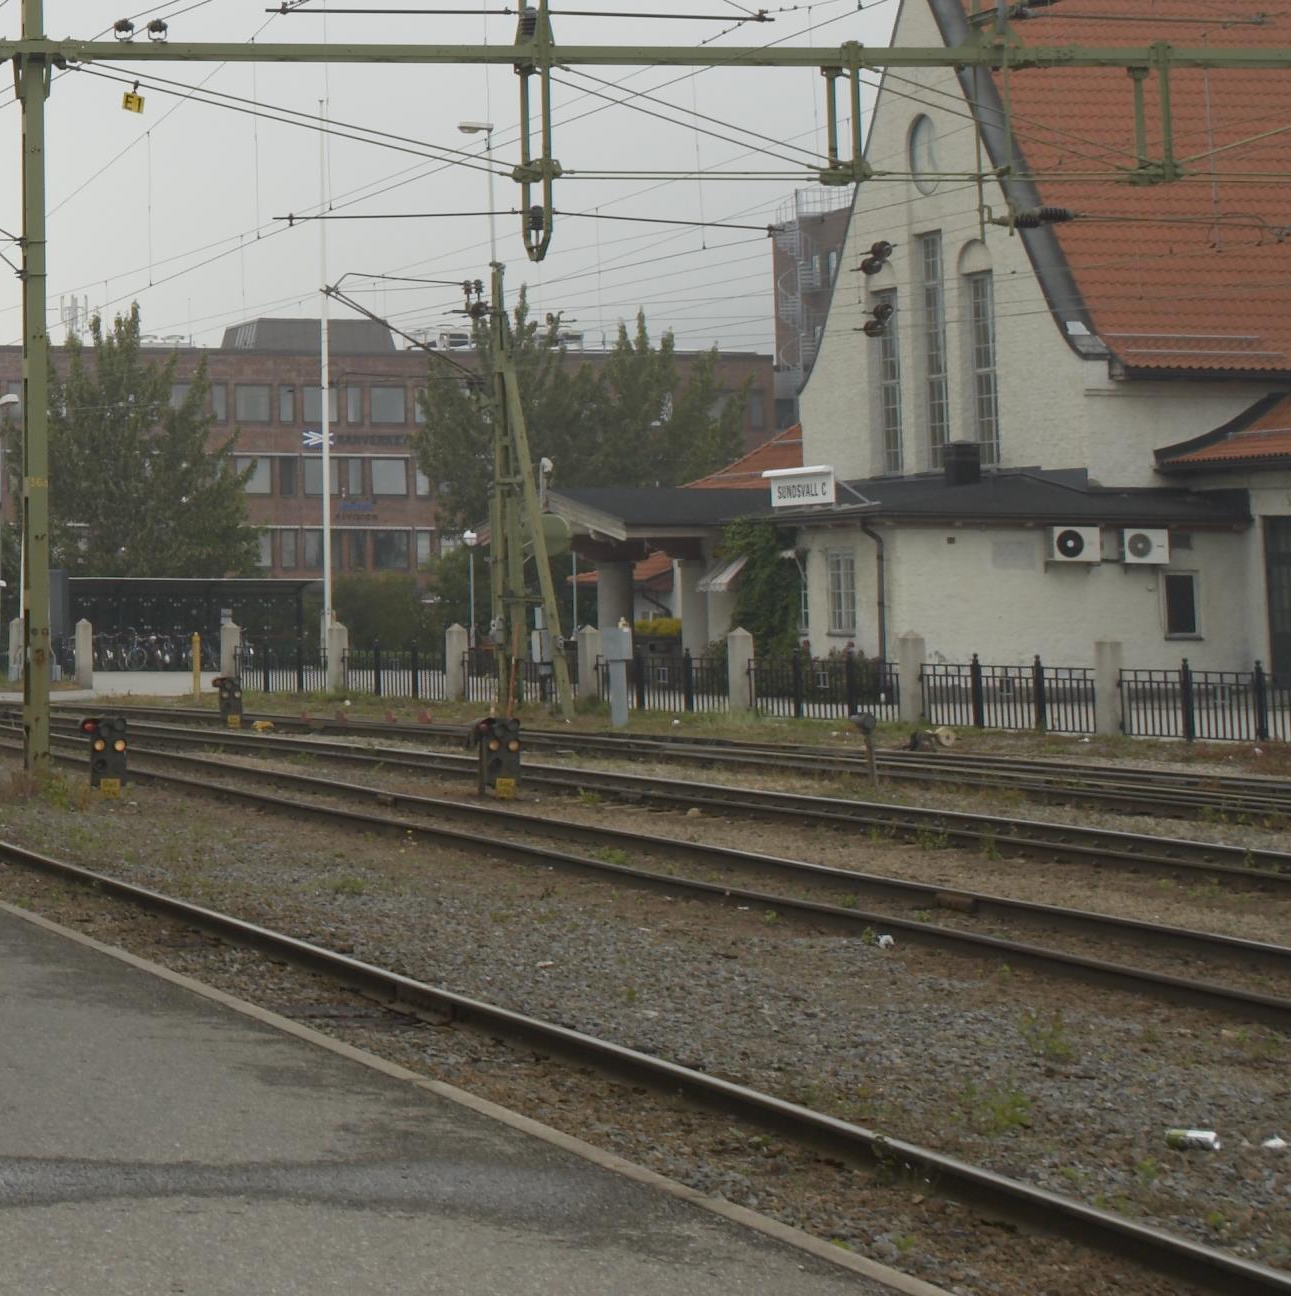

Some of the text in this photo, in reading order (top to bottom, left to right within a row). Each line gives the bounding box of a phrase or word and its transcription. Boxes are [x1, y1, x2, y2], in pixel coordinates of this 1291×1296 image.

[125, 94, 142, 112] E1
[777, 482, 827, 500] SUNDSVALL C
